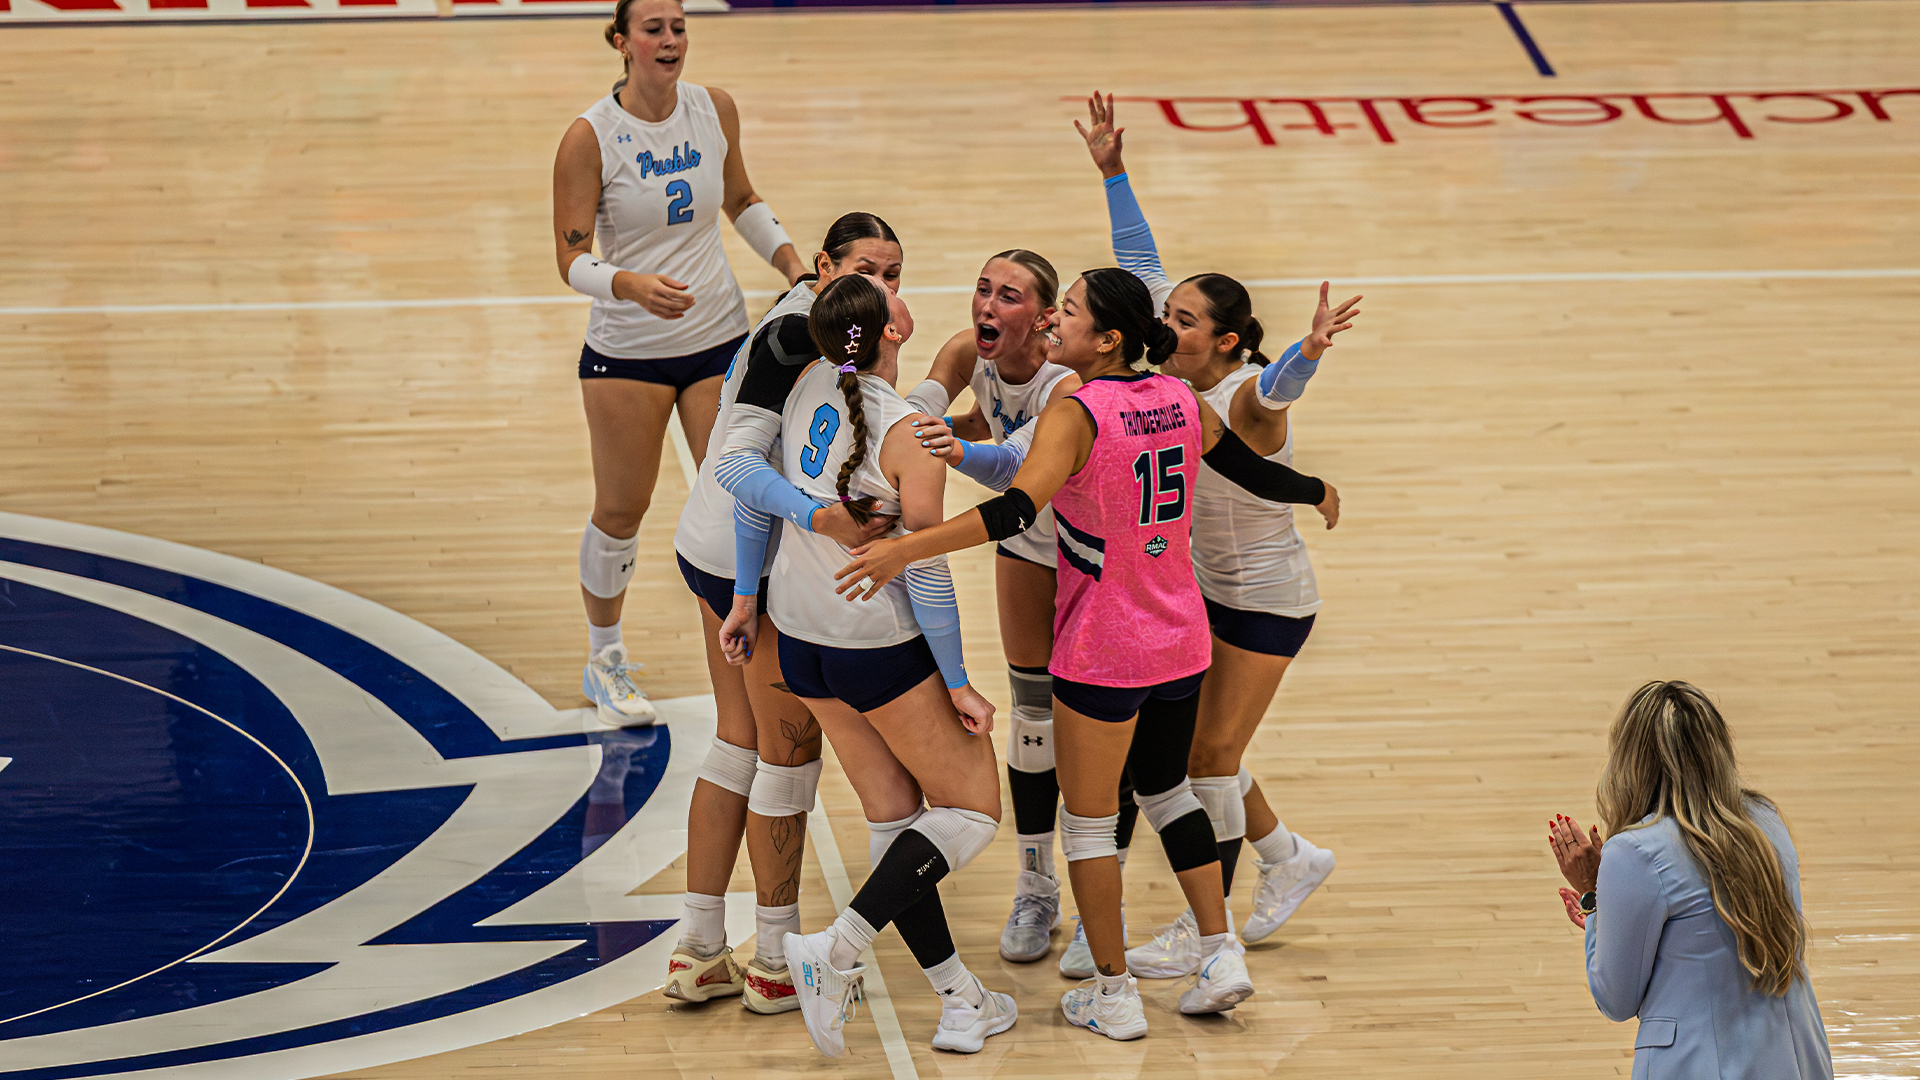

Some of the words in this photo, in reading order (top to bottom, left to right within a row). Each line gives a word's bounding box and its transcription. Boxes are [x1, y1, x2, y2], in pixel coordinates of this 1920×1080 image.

[1156, 87, 1920, 147] uchealth
[636, 141, 701, 179] Pueblo
[665, 179, 694, 226] 2
[800, 402, 841, 480] 9
[1132, 443, 1185, 526] 15
[1145, 541, 1167, 552] RMAC
